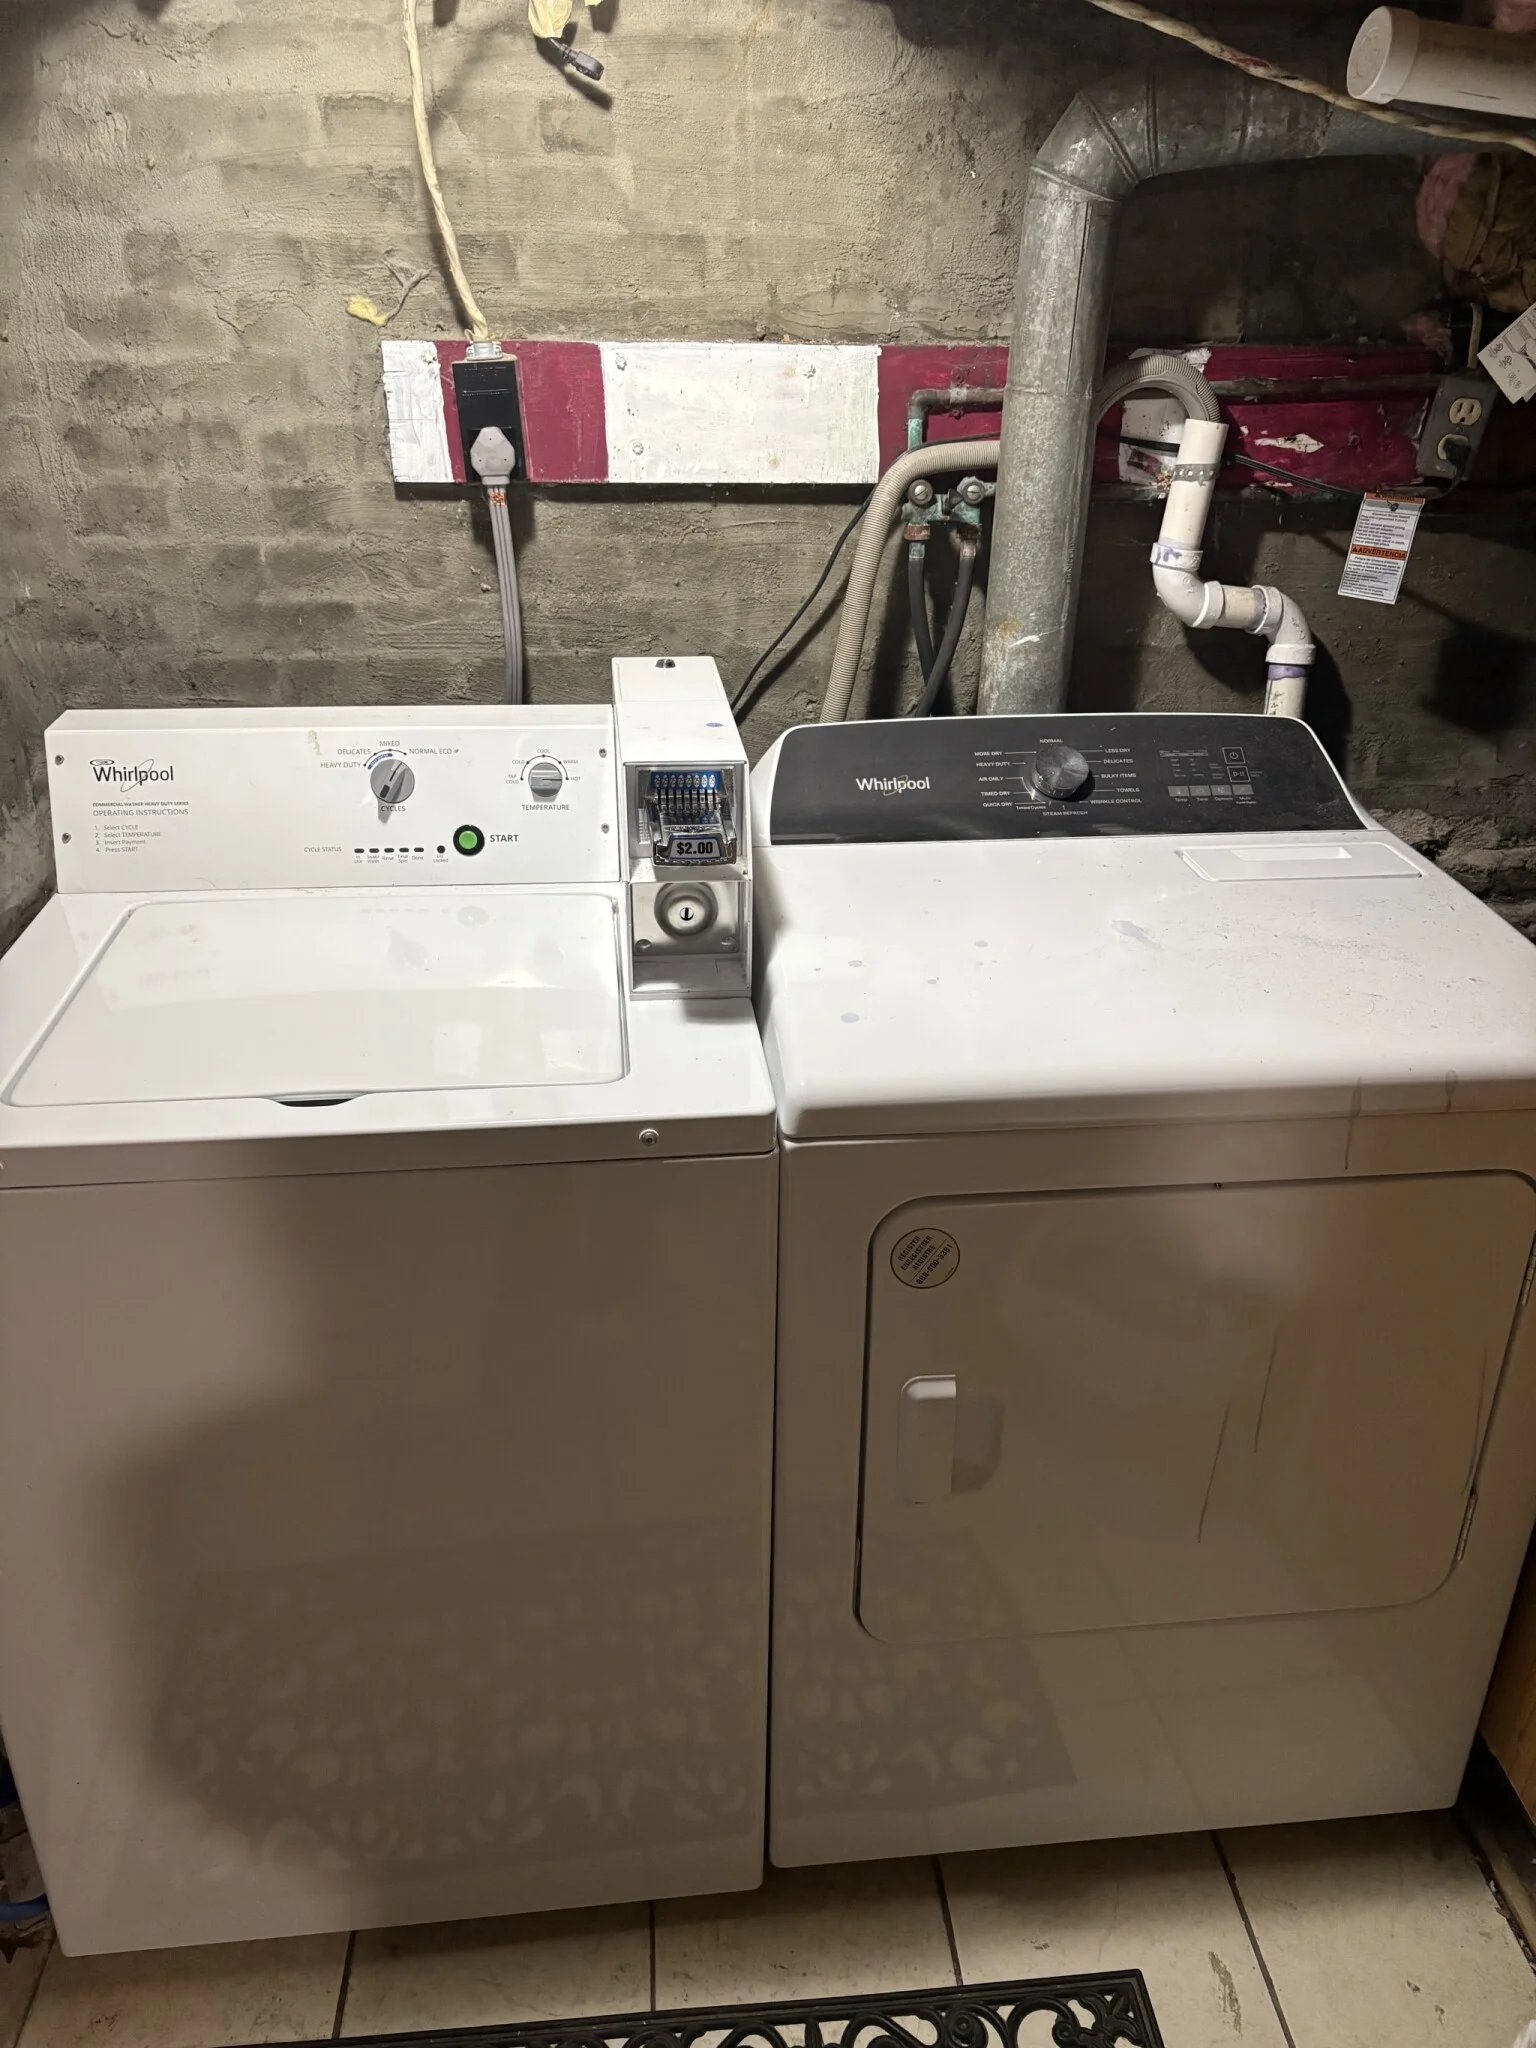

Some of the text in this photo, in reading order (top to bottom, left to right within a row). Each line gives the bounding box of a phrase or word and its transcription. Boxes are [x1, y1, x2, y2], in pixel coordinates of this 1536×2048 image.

[1357, 547, 1406, 559] ADVERTENCIA
[92, 764, 174, 787] Whirlpool
[856, 776, 930, 793] Whirlpool
[92, 809, 134, 817] OPERATING
[490, 834, 519, 842] START
[676, 842, 713, 856] $2.00
[898, 1236, 921, 1262] REGISTER
[900, 1236, 932, 1270] ENREGISTRER
[912, 1245, 936, 1270] REGISTRE
